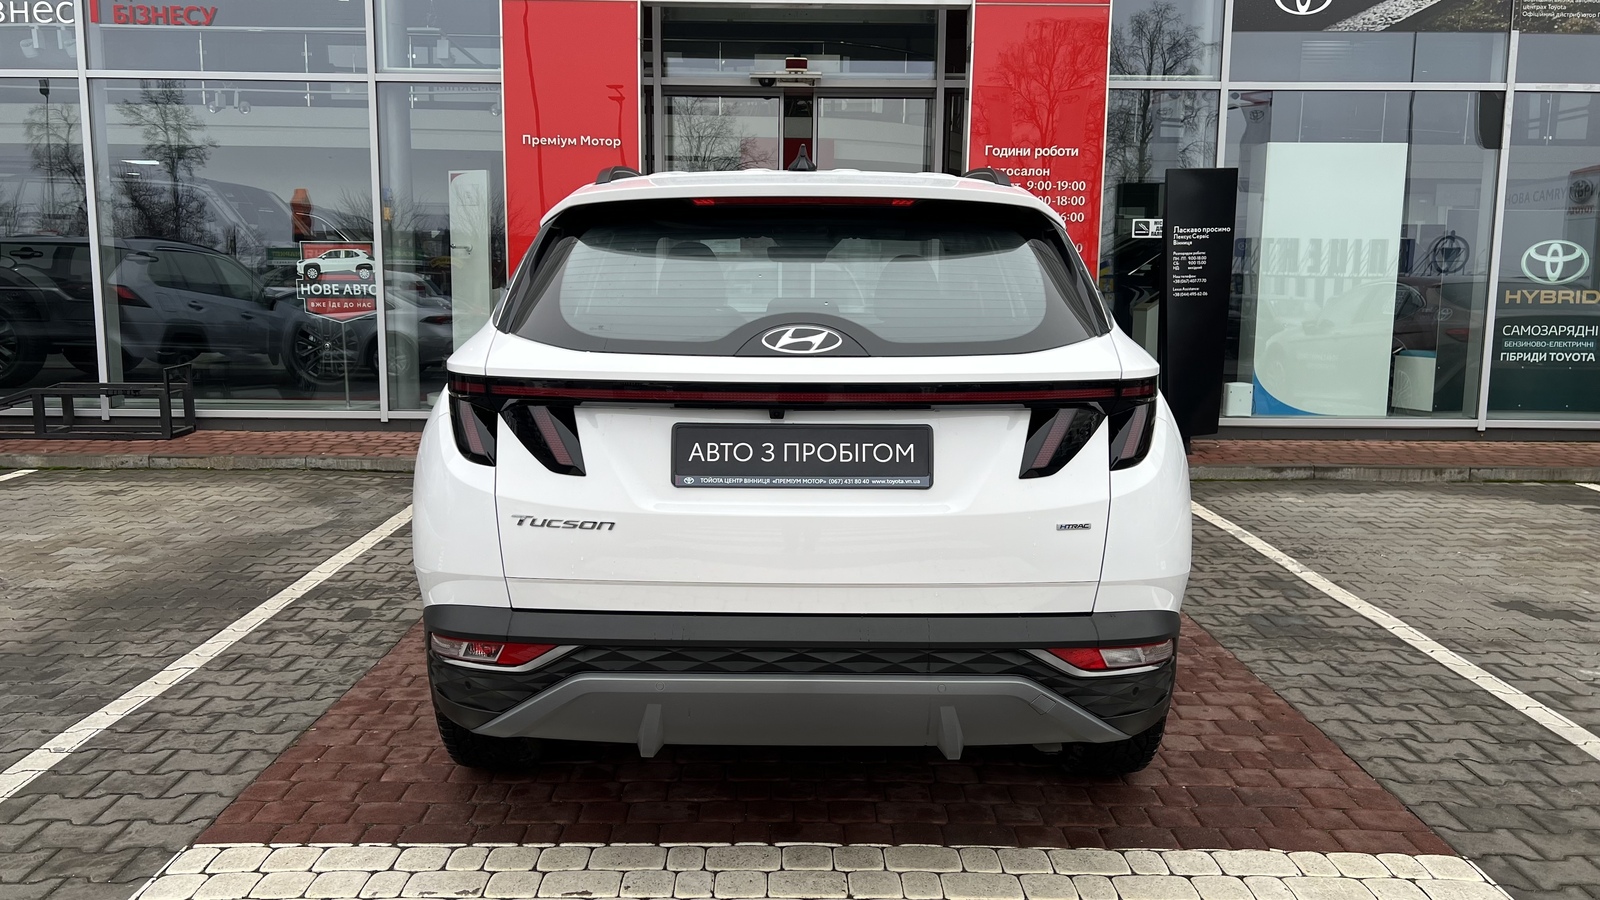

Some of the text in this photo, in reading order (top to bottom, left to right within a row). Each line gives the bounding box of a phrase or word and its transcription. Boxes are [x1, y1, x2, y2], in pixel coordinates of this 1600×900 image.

[113, 4, 216, 26] БІЗНЕСУ
[522, 134, 622, 149] Преміум Мотор
[984, 145, 1079, 159] Години роботи
[1026, 181, 1086, 191] 9:00-19:00
[1202, 226, 1231, 234] просимо
[300, 283, 377, 295] НОВЕ АВТО
[1504, 289, 1600, 305] HYBRID
[328, 300, 341, 308] ЇДЕ
[1502, 325, 1599, 338] САМОЗАРЯДНІ
[1504, 340, 1594, 348] БЕНЗИНОВО-ЕЛЕКТРИЧНІ
[1500, 352, 1596, 362] ГІБРИДИ TOYOTA
[688, 442, 915, 463] АВТО З ПРОБІГОМ
[700, 476, 724, 484] ТОЙОТА
[724, 477, 743, 485] ЦЕНТР
[743, 477, 771, 485] ВІННИЦЯ
